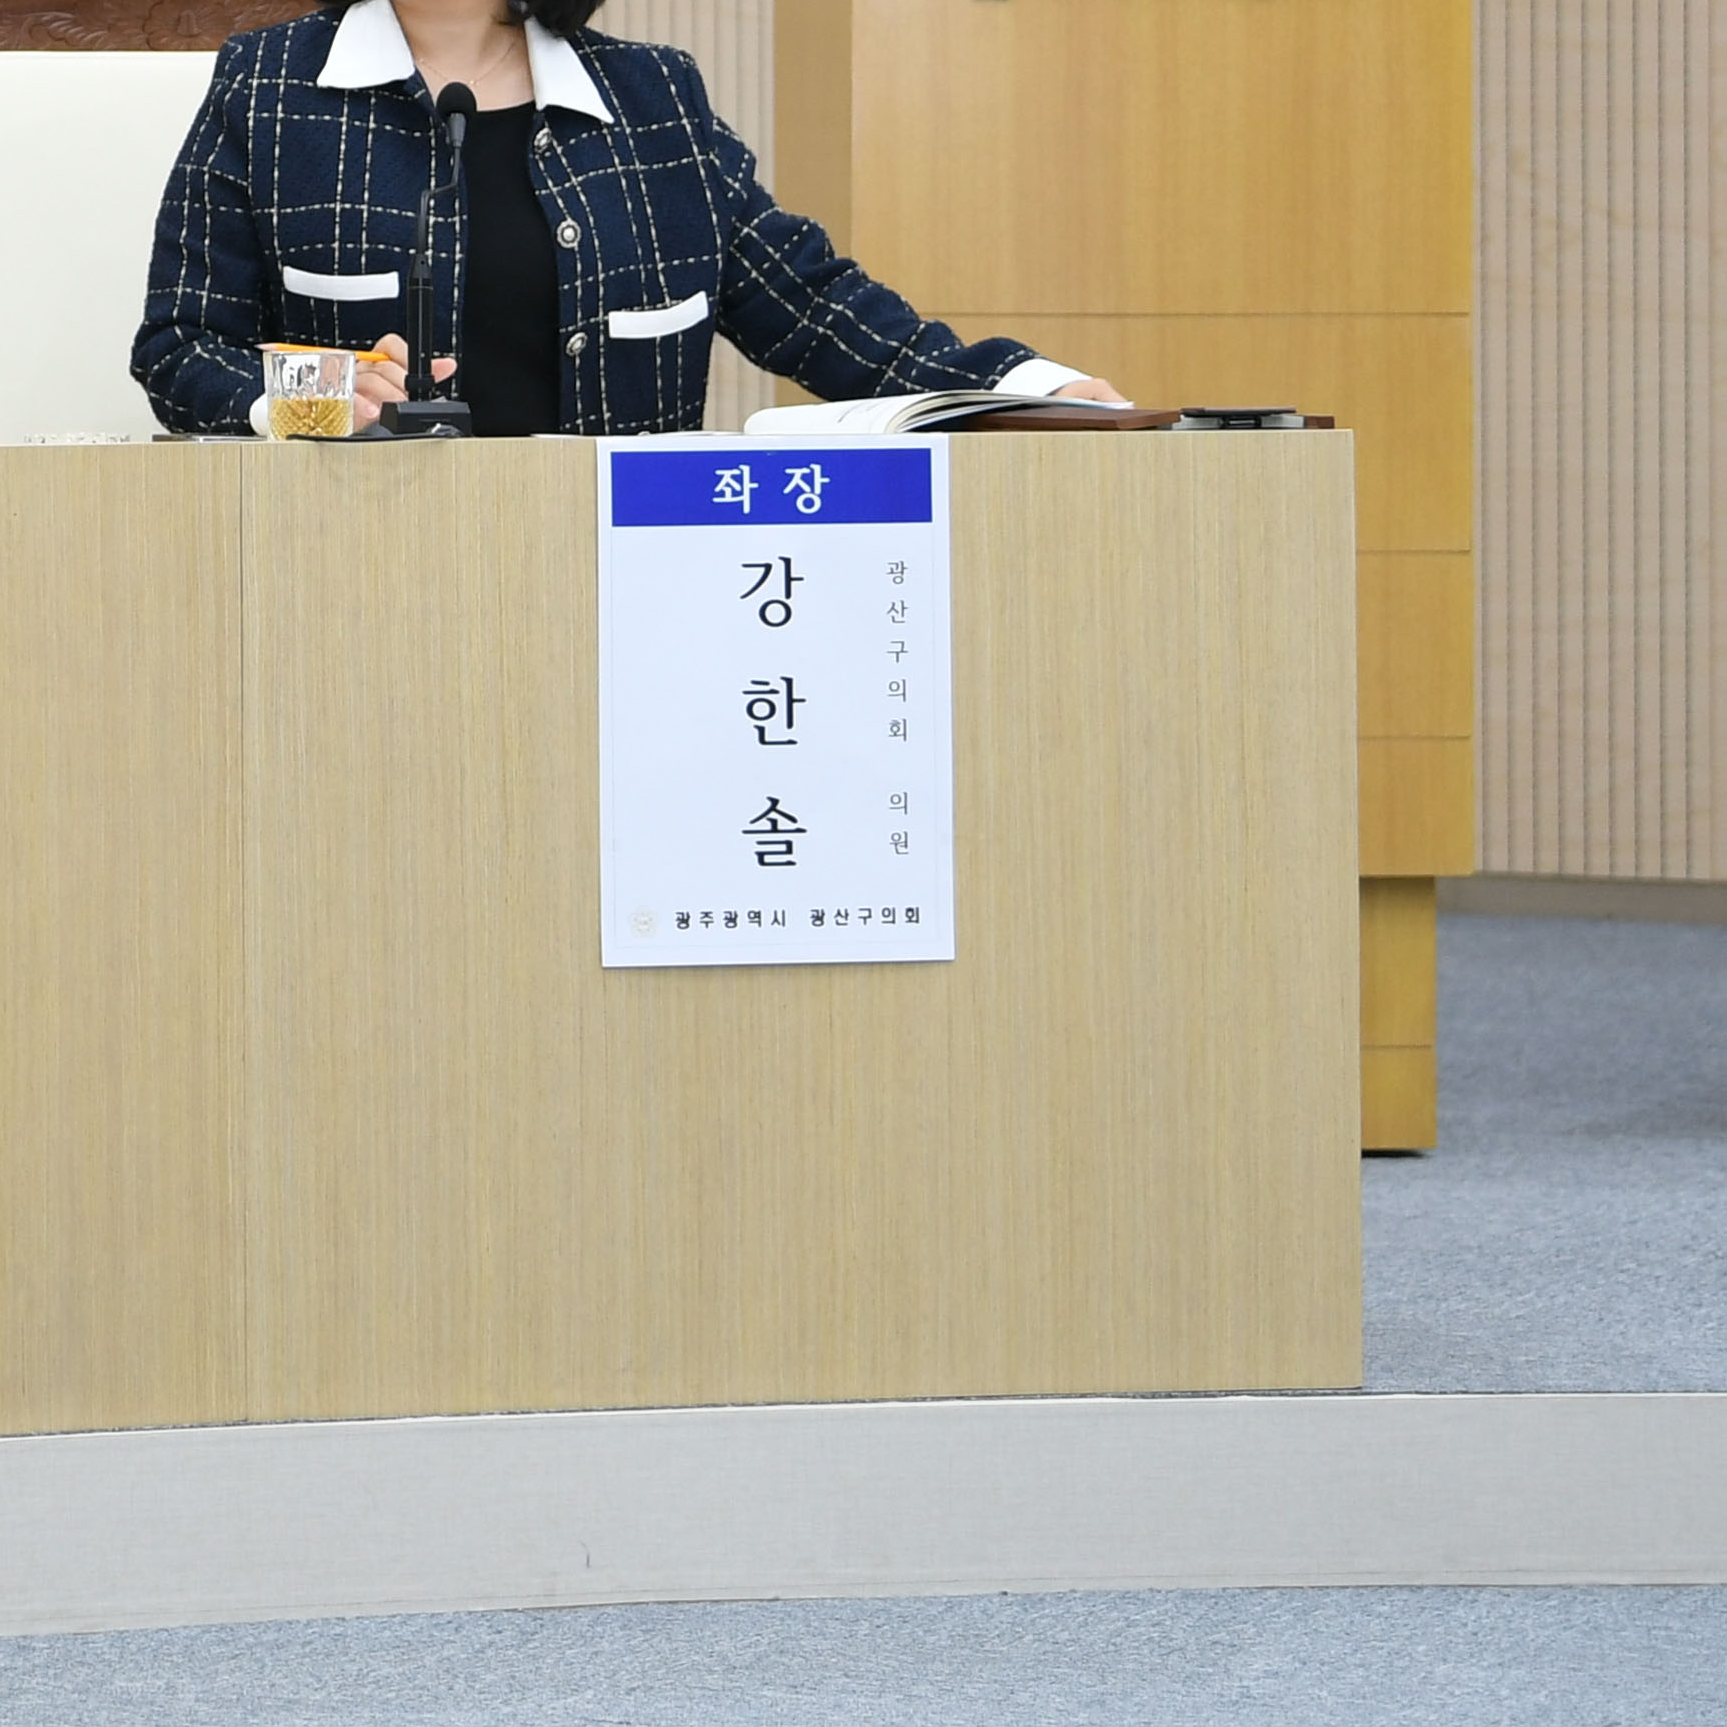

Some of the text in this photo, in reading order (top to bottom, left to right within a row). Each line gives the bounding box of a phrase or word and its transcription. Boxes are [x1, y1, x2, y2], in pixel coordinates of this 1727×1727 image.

[711, 462, 832, 515] 좌장
[739, 555, 808, 868] 강한솔
[885, 559, 910, 856] 광산구의회 의원
[674, 905, 921, 931] 광주광역시 광산구의회
